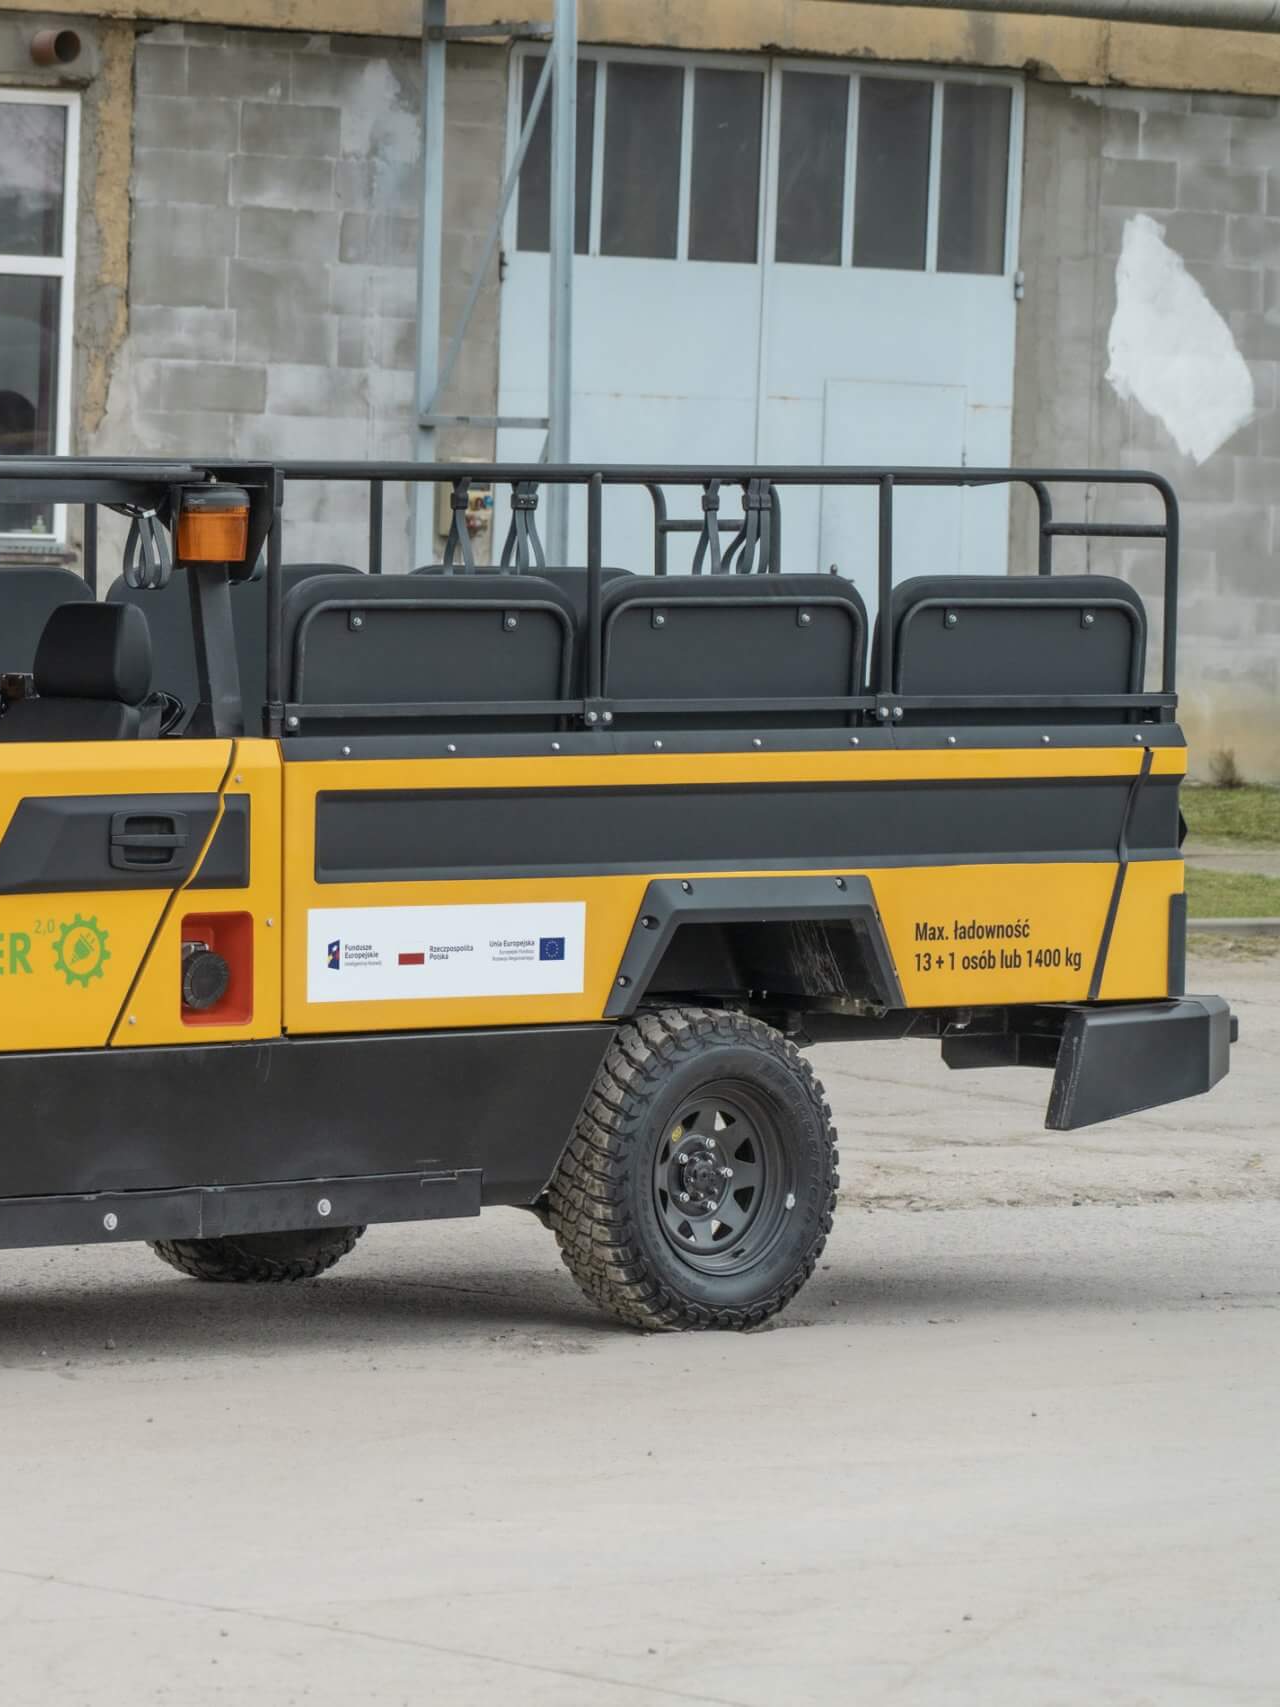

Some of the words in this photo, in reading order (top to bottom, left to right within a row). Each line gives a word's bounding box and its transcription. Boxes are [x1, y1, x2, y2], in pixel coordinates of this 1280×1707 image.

[914, 922, 949, 941] Max.
[953, 918, 1031, 940] ładowność
[914, 953, 932, 972] 13
[935, 957, 945, 968] +
[949, 952, 956, 970] 1
[961, 949, 996, 970] osób
[1000, 949, 1022, 969] lub
[1026, 948, 1061, 969] 1400
[1065, 947, 1082, 971] kg
